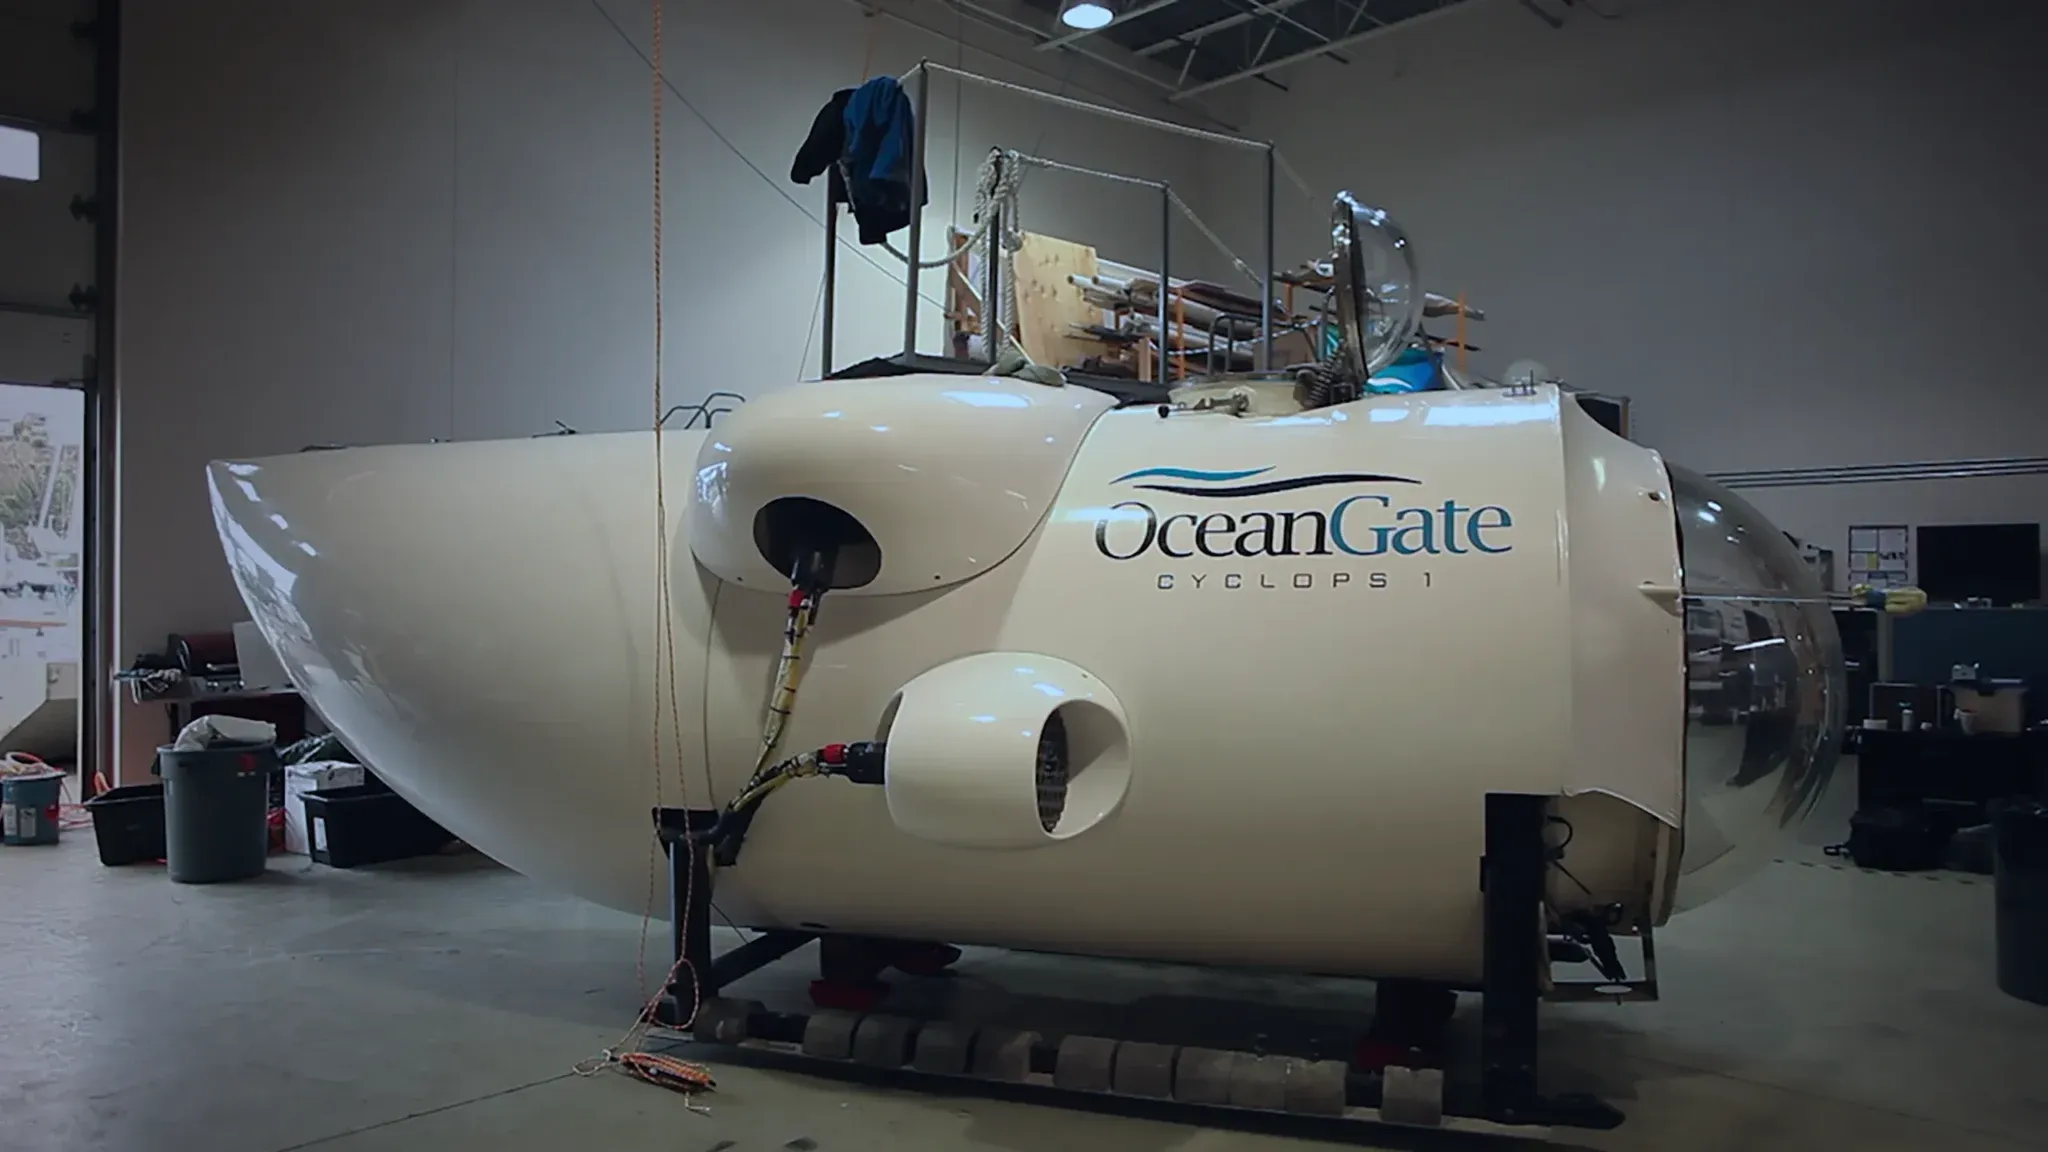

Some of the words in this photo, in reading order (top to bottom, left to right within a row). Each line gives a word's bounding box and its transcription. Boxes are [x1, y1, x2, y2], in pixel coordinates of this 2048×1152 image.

[1095, 495, 1512, 560] OceanGate
[1157, 573, 1387, 589] CYCLOPS
[1423, 572, 1432, 588] 1
